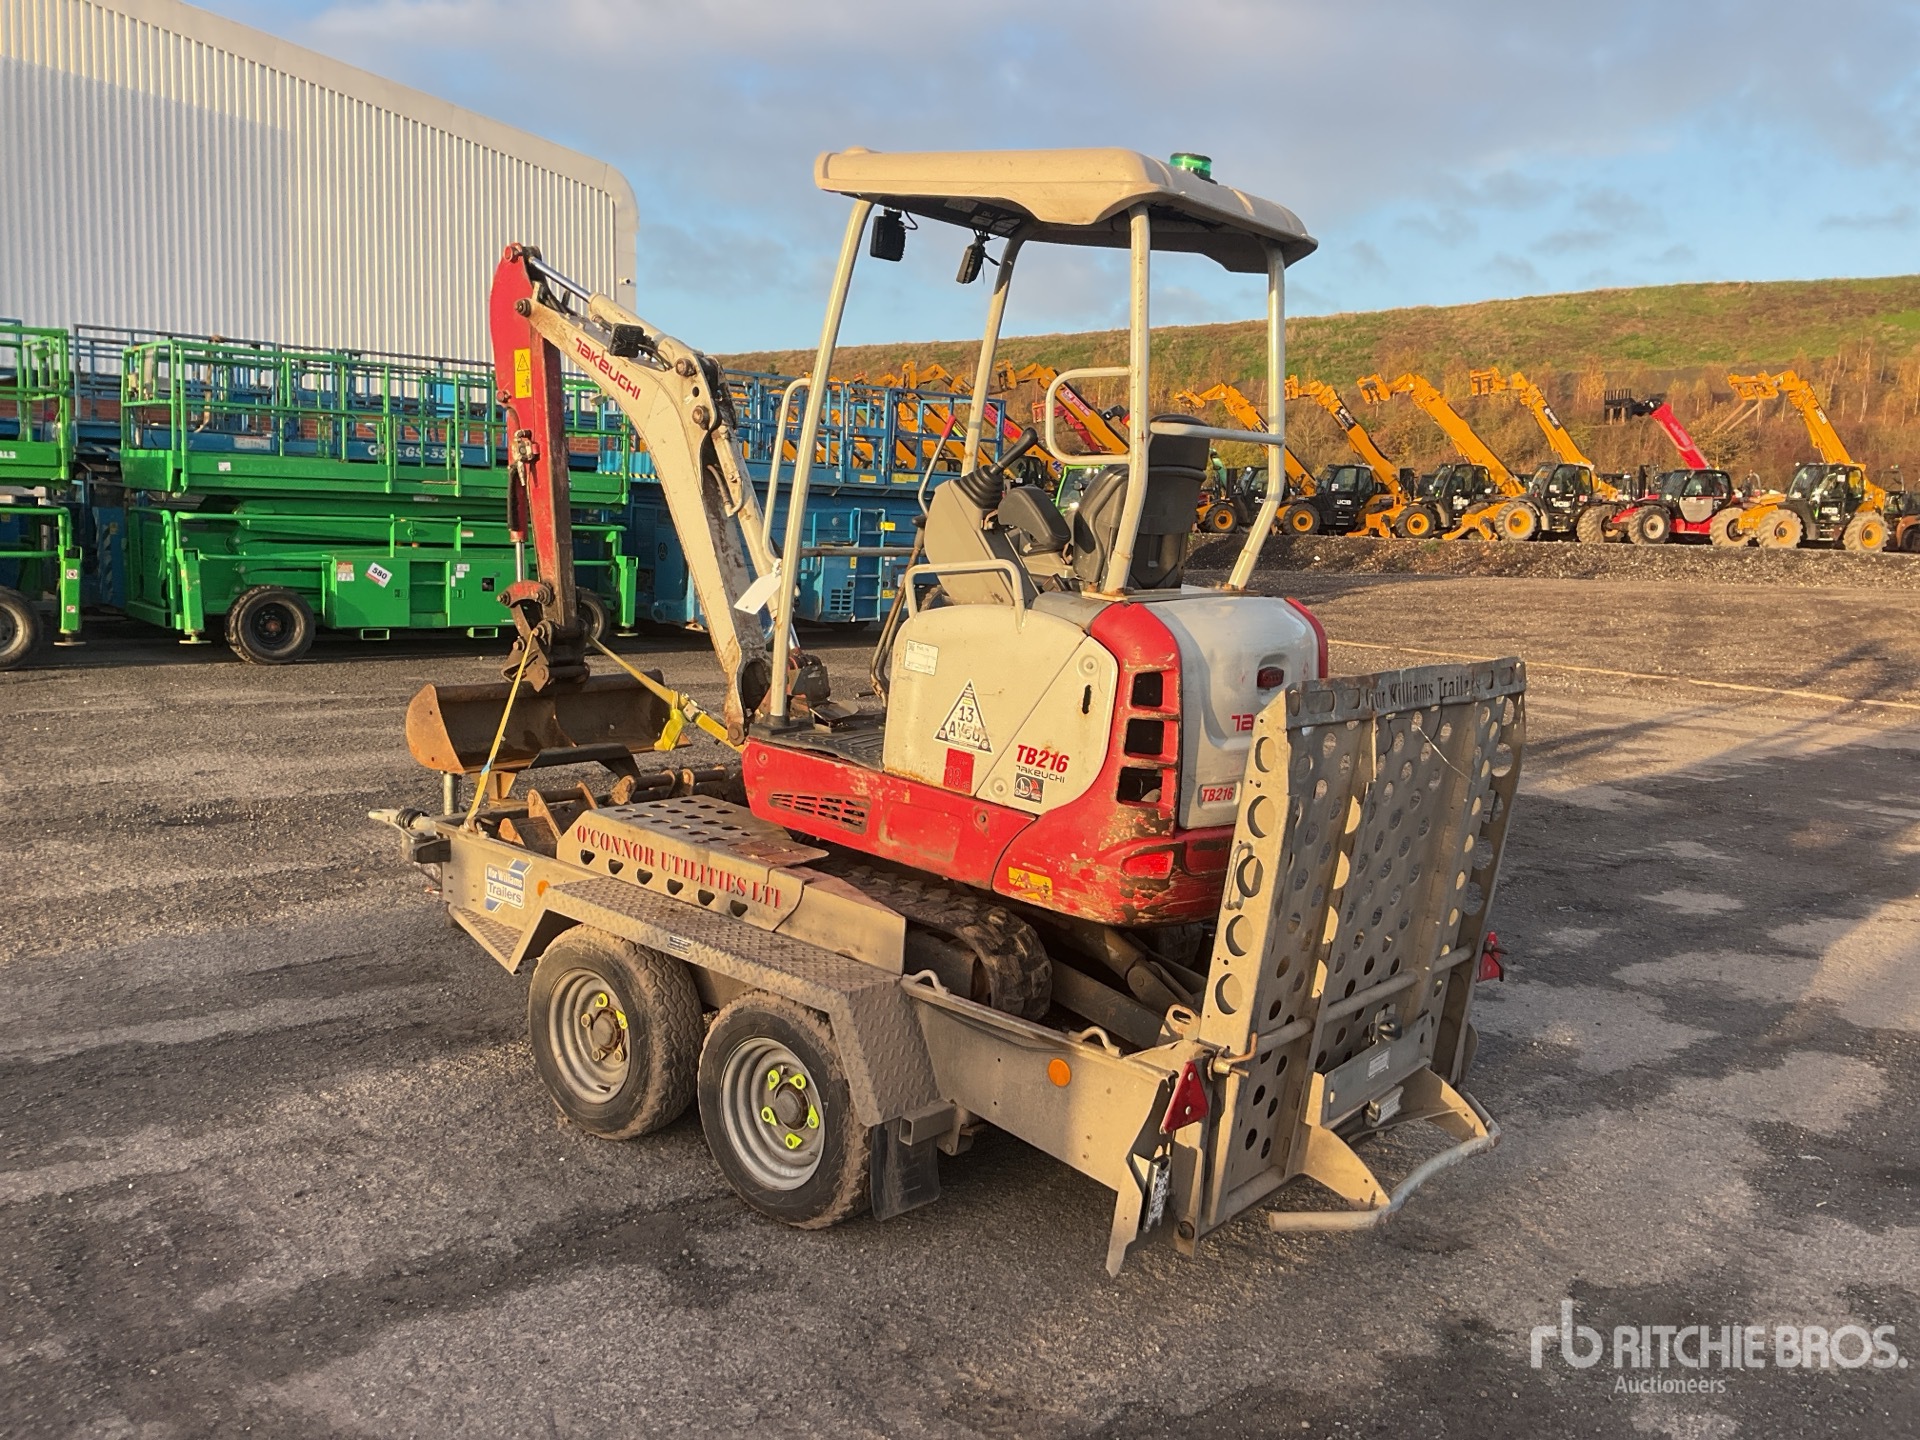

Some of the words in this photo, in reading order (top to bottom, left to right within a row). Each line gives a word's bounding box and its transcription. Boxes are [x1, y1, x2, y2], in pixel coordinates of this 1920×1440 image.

[575, 337, 641, 401] TAKEUCHI
[1551, 498, 1570, 508] JCB
[1821, 506, 1838, 514] JCB
[371, 566, 388, 580] 580
[1388, 680, 1434, 706] Williams
[957, 705, 975, 723] 13
[1016, 744, 1070, 773] TB216
[1015, 764, 1066, 784] TAKEUCHI
[1201, 787, 1234, 803] TB216
[576, 825, 656, 868] O'CONNOR
[660, 851, 748, 898] UTILITIES
[488, 881, 522, 904] Trailers
